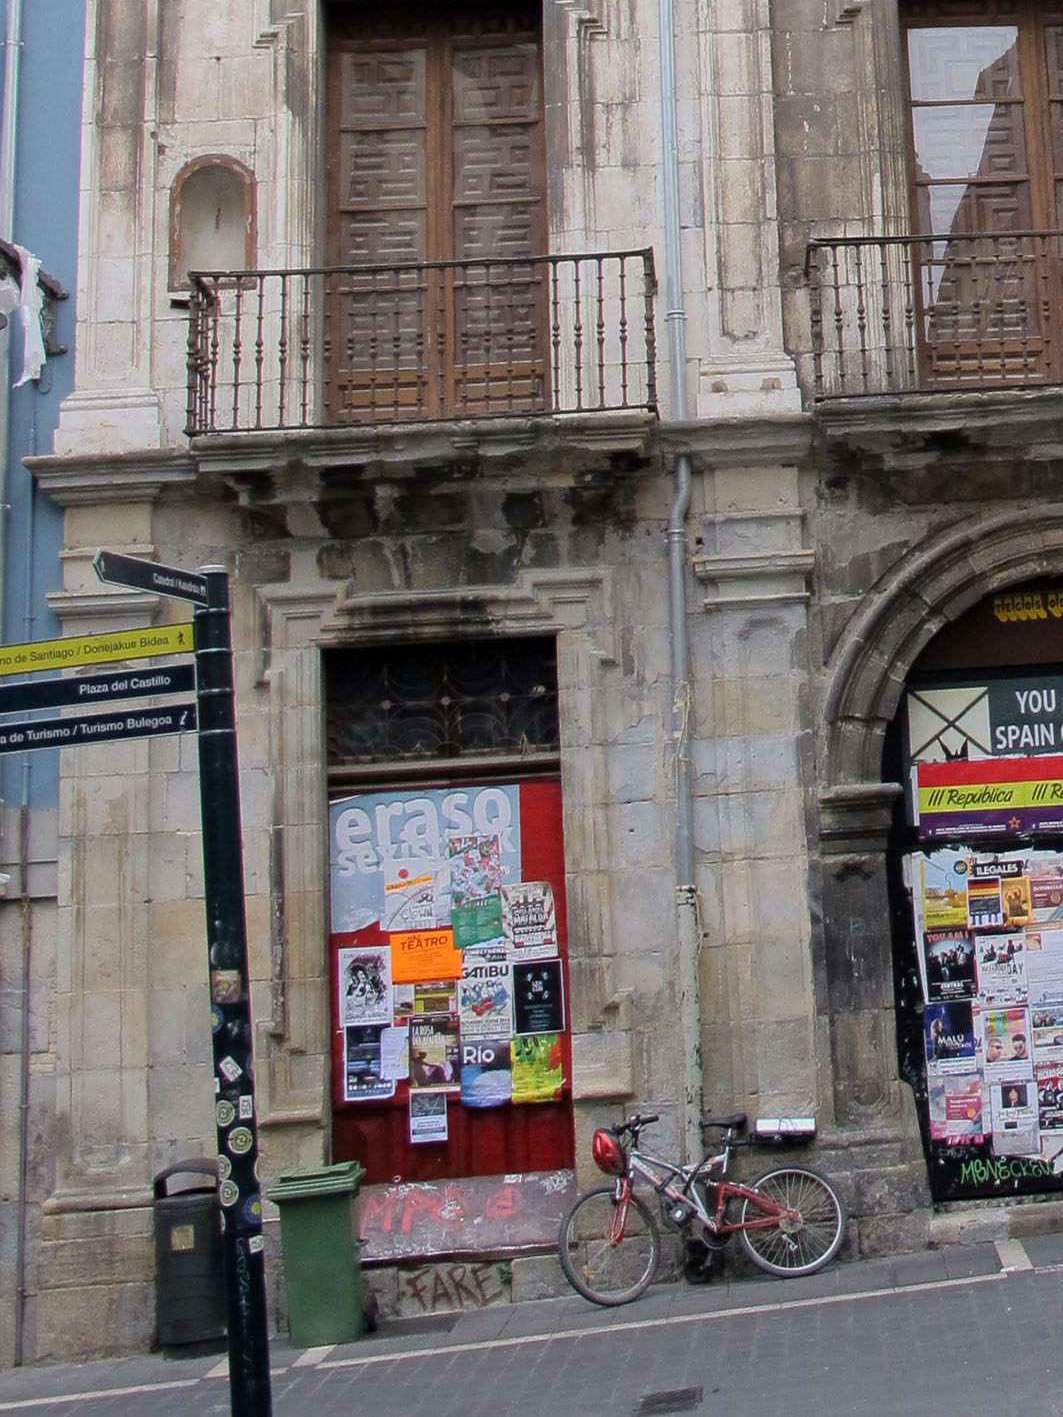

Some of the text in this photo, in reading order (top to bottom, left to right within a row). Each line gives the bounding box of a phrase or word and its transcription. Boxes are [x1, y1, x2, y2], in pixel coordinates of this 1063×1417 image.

[15, 654, 27, 663] de
[30, 648, 74, 663] Santiago
[84, 640, 137, 656] Donejakue
[140, 635, 169, 648] Bidea
[79, 676, 171, 696] Plaza del Castillo
[1016, 688, 1056, 714] YOU
[10, 732, 24, 743] de
[26, 727, 70, 741] Turismo
[80, 721, 124, 735] Turismo
[127, 714, 172, 730] Bulegoa
[996, 723, 1055, 750] SPAIN
[947, 787, 1014, 808] República
[976, 862, 1019, 876] ILEGALES
[400, 935, 448, 951] TEATRO
[462, 964, 509, 980] GATIBU
[463, 1046, 495, 1064] Río
